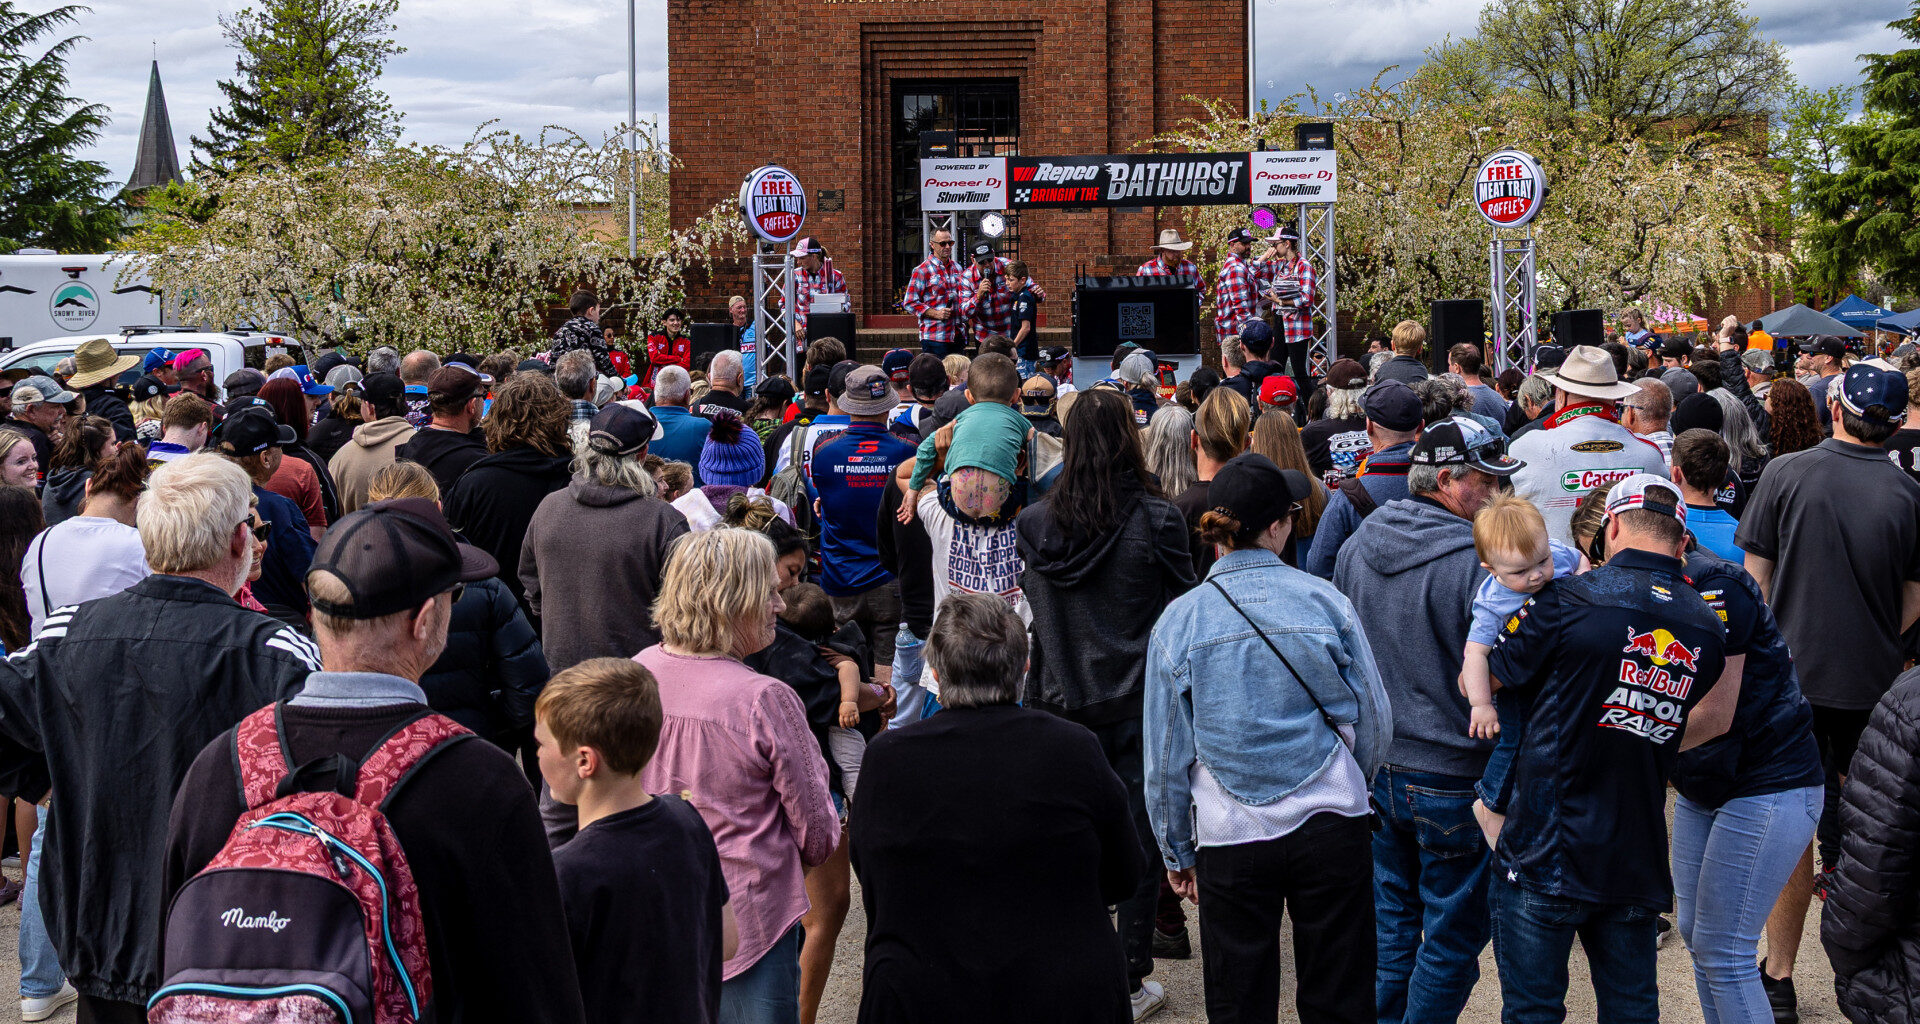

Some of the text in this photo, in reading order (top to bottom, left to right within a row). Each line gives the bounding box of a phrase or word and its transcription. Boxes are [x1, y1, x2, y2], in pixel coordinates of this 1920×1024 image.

[1033, 162, 1099, 184] Repco
[1105, 161, 1243, 200] BATHURST
[1255, 171, 1314, 180] Pioneer
[1488, 165, 1523, 181] FREE
[761, 181, 793, 195] FREE
[924, 178, 983, 188] Pioneer
[1267, 183, 1322, 197] ShowTime
[1479, 180, 1532, 204] MEAT TRAY
[936, 191, 991, 204] ShowTime
[1031, 187, 1100, 202] BRINGIN' THE
[754, 197, 778, 217] MEAT
[779, 196, 802, 215] TRAY
[1487, 198, 1525, 217] RAFFLE'S
[764, 213, 796, 232] RAFFLE'S
[834, 465, 844, 474] MT
[846, 465, 886, 474] PANORAMA
[1582, 471, 1634, 488] Castr
[948, 555, 982, 576] ROBIN
[1619, 658, 1694, 700] Red Bull
[220, 908, 291, 932] Mambo
